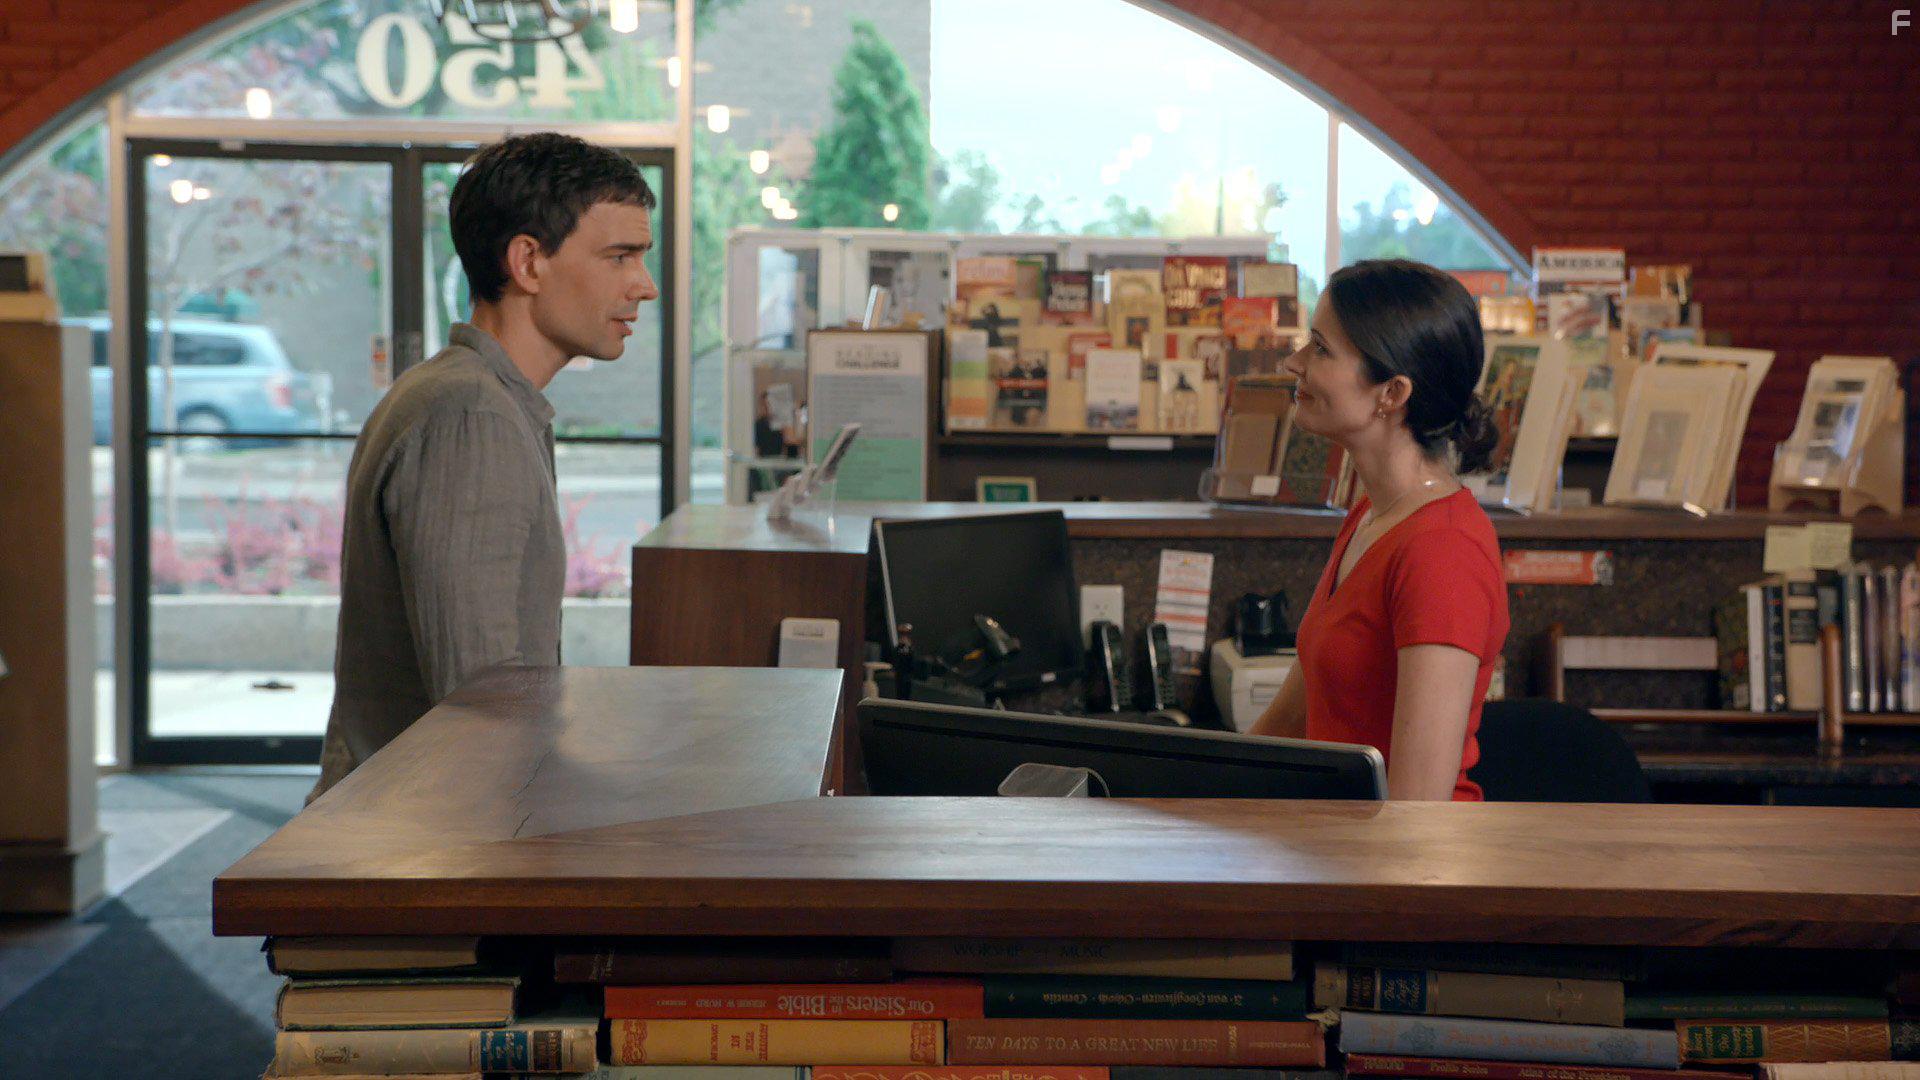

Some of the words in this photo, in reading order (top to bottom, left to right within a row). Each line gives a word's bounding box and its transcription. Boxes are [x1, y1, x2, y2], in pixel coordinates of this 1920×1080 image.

[778, 995, 825, 1015] Bible
[831, 1005, 841, 1014] in
[847, 996, 906, 1015] Sisters
[909, 1000, 934, 1014] Our
[966, 1036, 996, 1050] TEN
[1002, 1036, 1040, 1051] DAYS
[1045, 1037, 1065, 1051] TO
[1070, 1037, 1079, 1051] A
[1085, 1037, 1138, 1051] GREAT
[1141, 1037, 1181, 1051] NEW
[1182, 1038, 1218, 1051] LIFE
